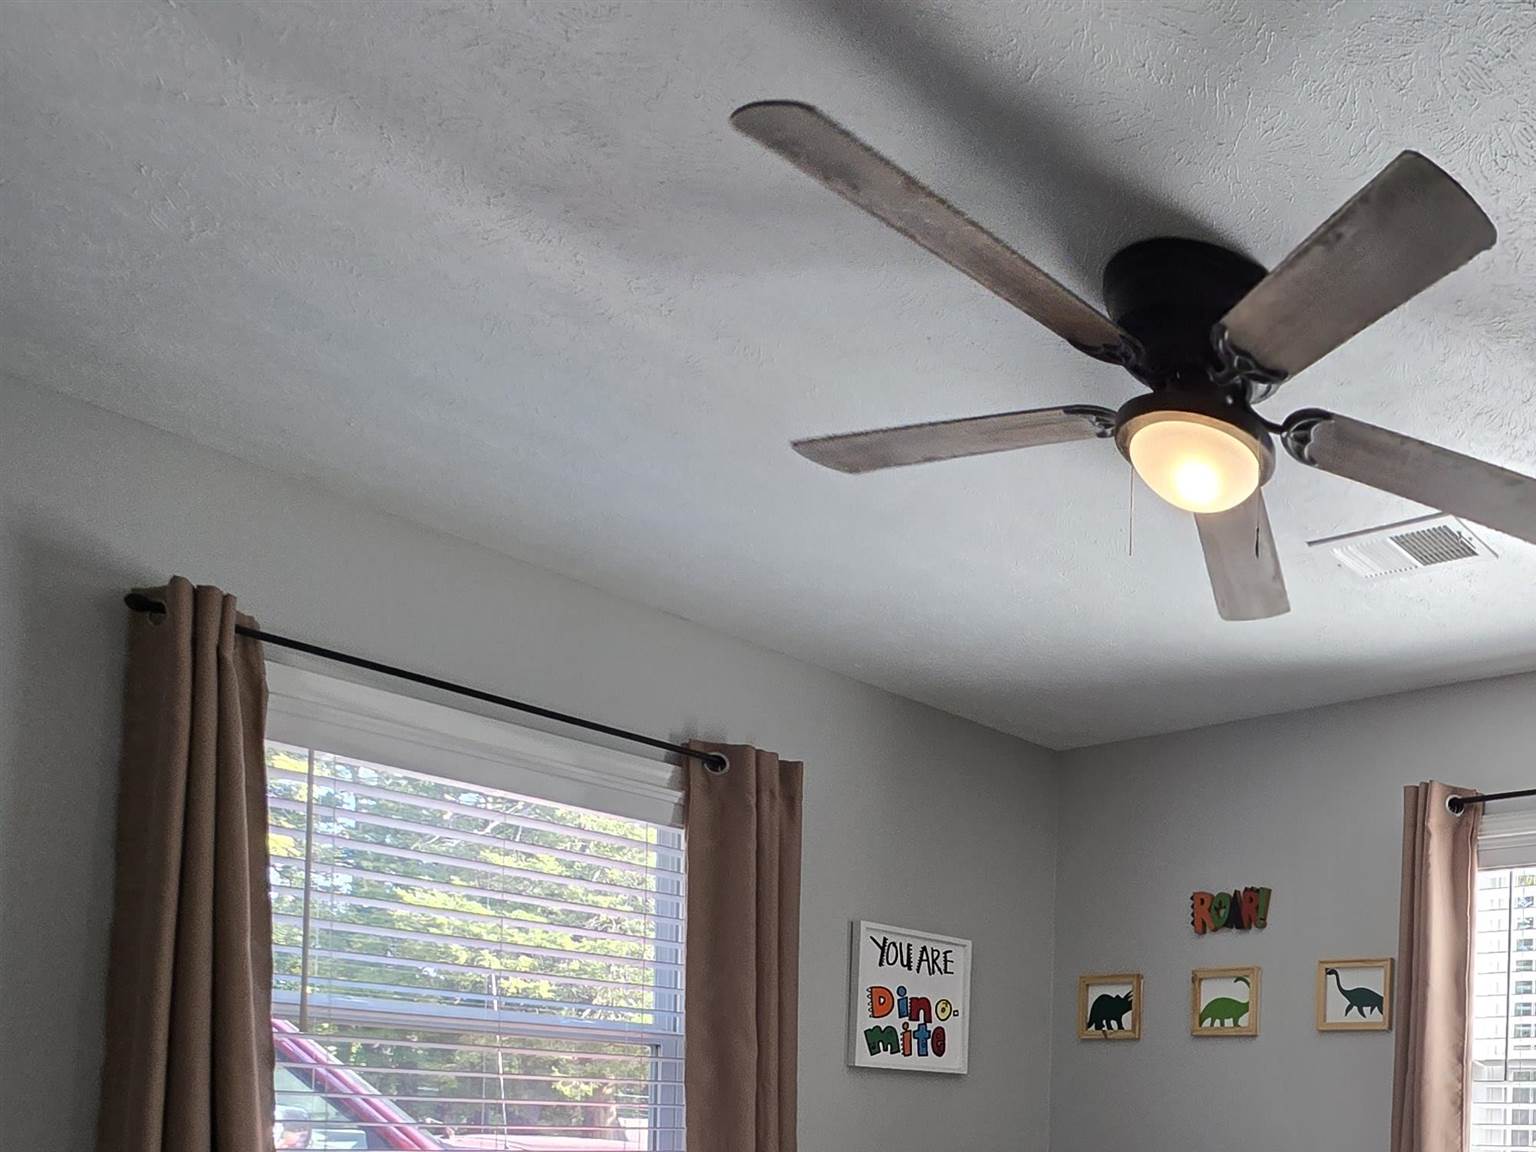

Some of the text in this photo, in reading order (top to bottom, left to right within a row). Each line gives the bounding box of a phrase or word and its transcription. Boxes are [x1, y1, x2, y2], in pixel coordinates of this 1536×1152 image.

[1190, 886, 1272, 935] ROAR!
[870, 935, 954, 976] YOU ARE
[864, 1021, 946, 1057] mite
